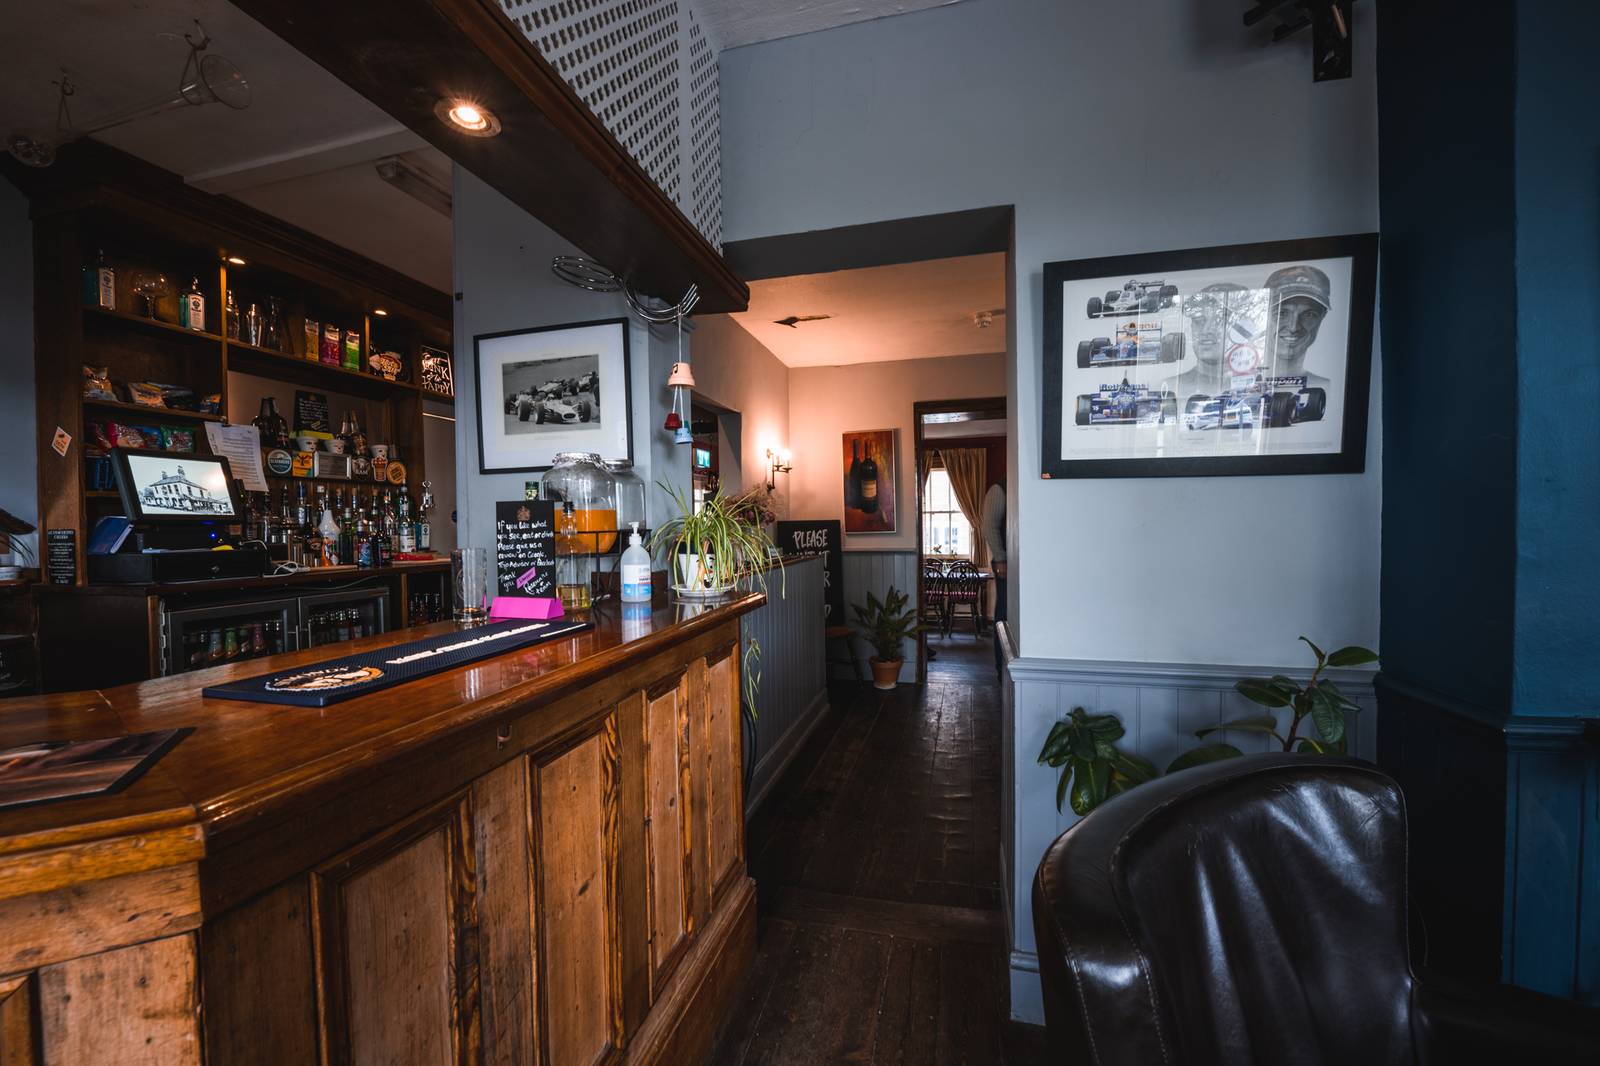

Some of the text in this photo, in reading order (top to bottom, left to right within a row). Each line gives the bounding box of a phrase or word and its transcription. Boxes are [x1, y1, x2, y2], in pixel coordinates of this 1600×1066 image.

[506, 524, 518, 533] you
[531, 520, 547, 529] what
[497, 533, 508, 543] you
[792, 529, 828, 549] PLEASE
